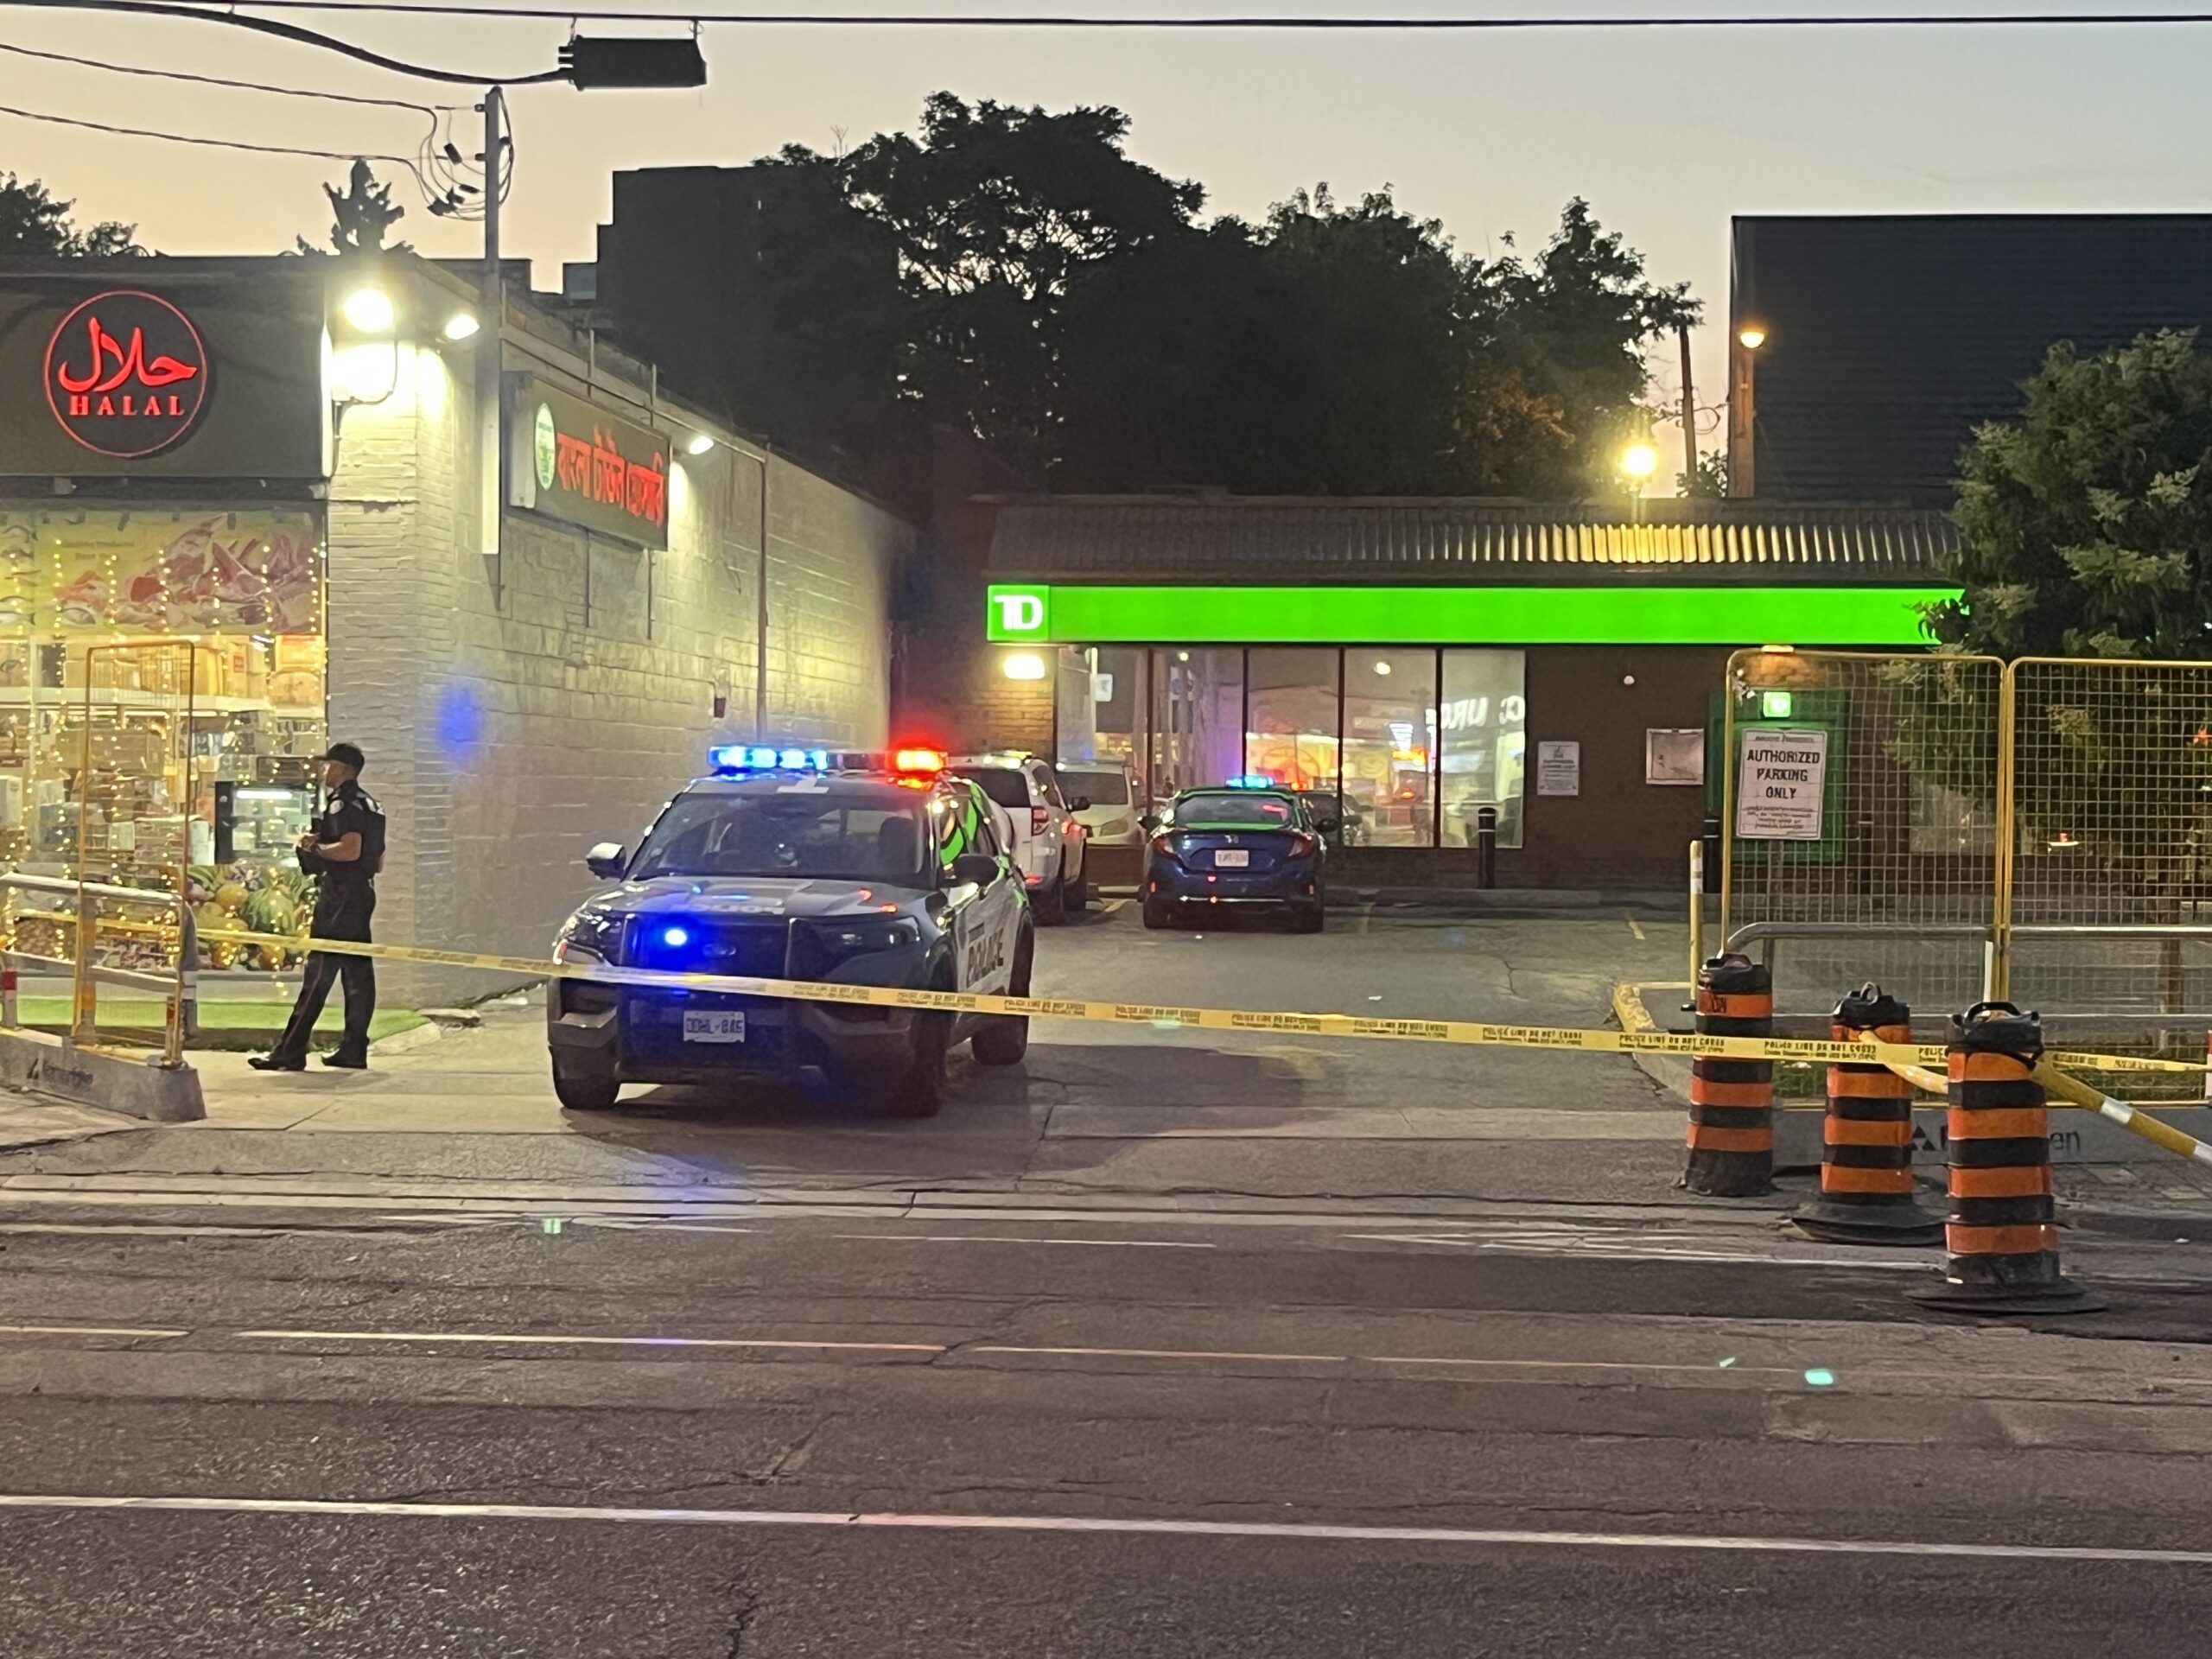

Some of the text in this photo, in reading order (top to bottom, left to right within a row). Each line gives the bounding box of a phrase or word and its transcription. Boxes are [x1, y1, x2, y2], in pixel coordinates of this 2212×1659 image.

[58, 317, 197, 392] حلال
[69, 395, 185, 416] HALAL
[993, 594, 1044, 631] TD
[1746, 749, 1821, 764] AUTHORIZED
[1757, 768, 1808, 782] PARKING
[1765, 786, 1797, 799] ONLY
[966, 927, 1004, 988] POLICE
